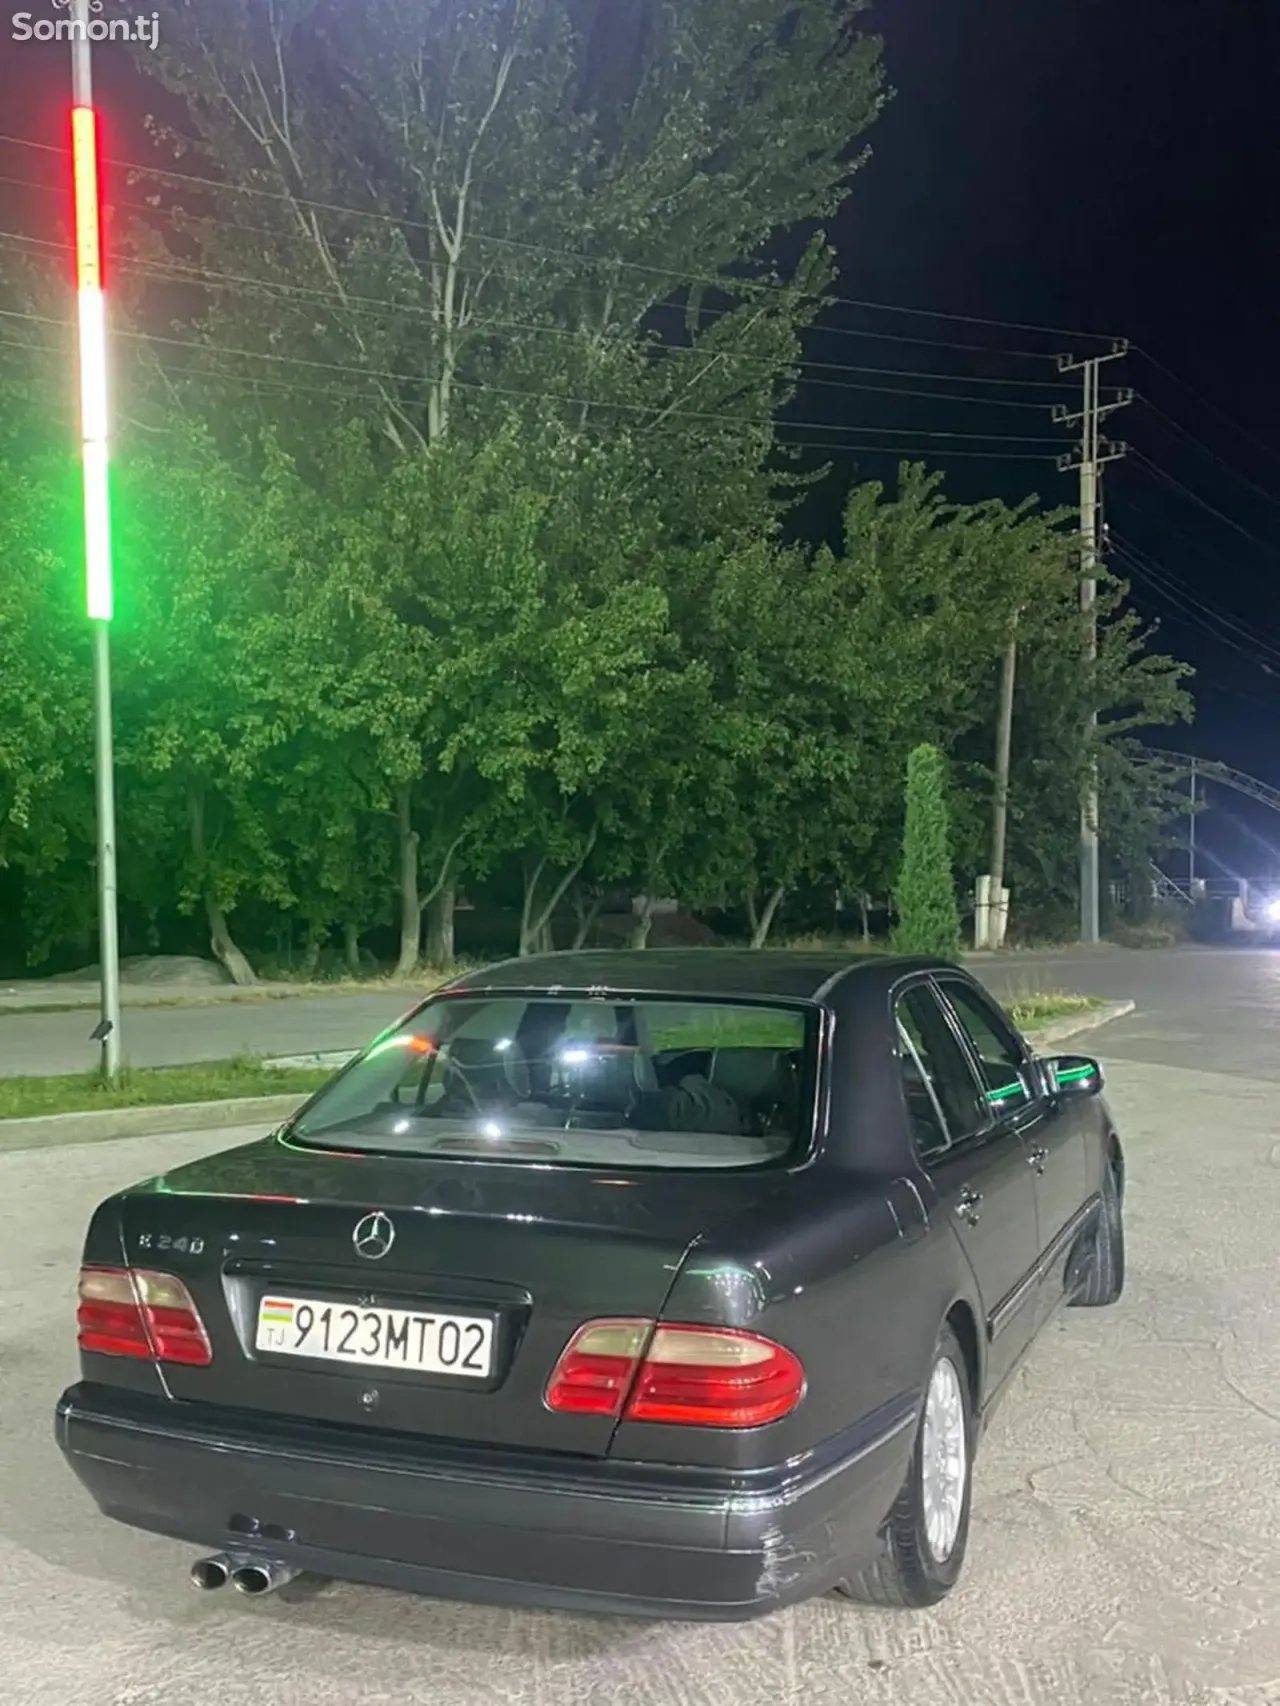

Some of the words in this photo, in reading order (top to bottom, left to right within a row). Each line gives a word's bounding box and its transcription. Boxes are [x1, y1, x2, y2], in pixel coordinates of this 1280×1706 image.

[157, 1234, 204, 1254] 240
[266, 1328, 285, 1346] TJ
[295, 1305, 485, 1370] 9123MT02
